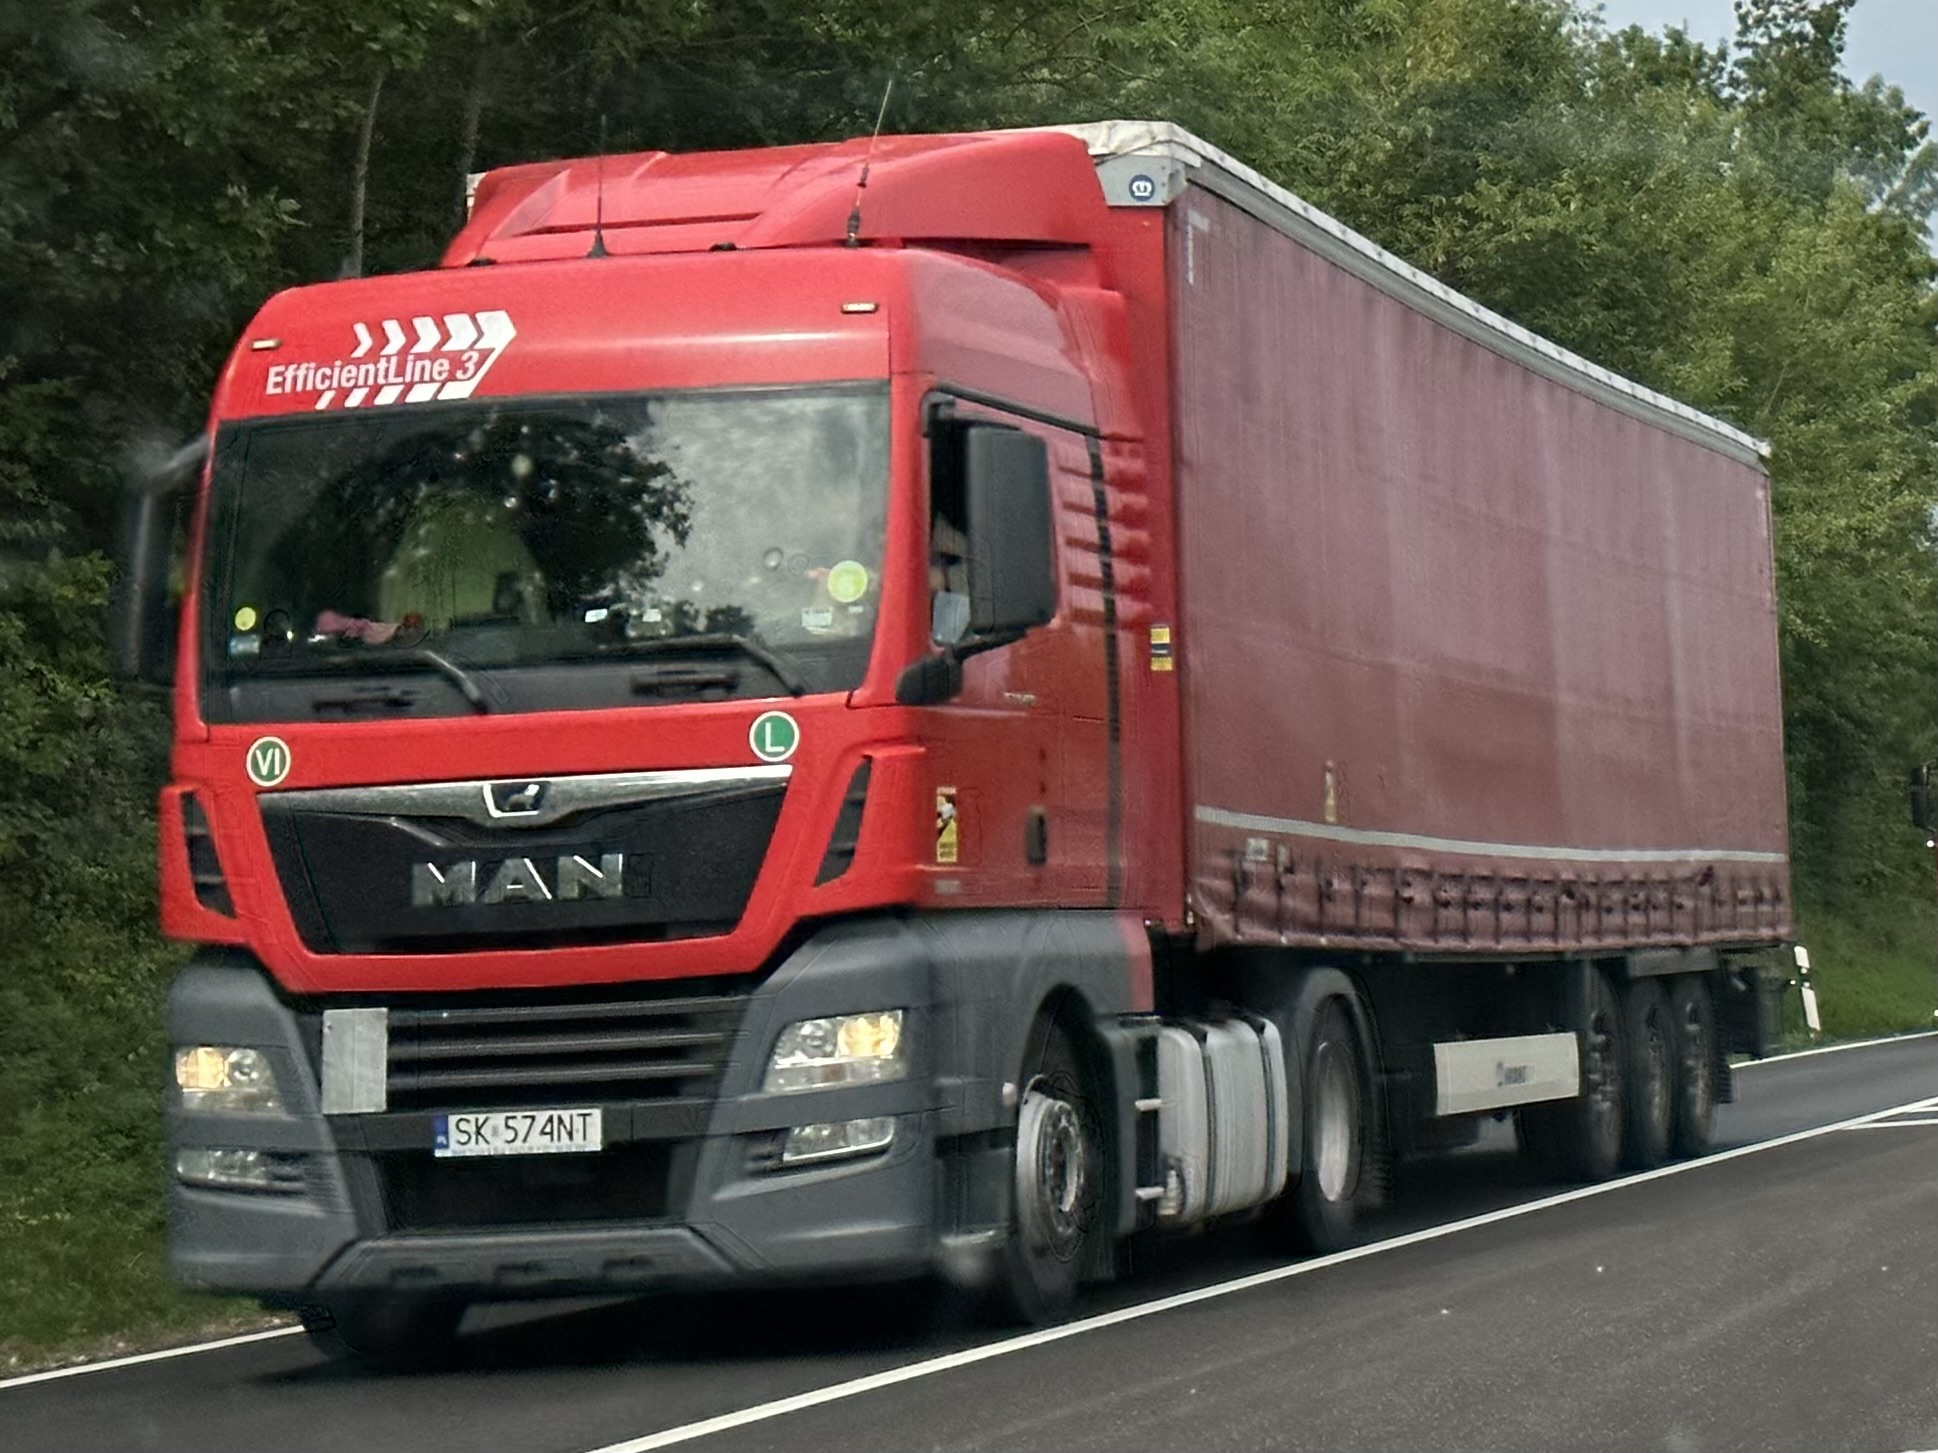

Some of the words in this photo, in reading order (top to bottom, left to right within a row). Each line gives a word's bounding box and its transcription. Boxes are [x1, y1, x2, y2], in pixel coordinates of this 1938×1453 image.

[265, 354, 450, 395] EfficientLine
[455, 350, 480, 380] 3
[765, 721, 786, 753] L
[255, 747, 280, 776] VI
[411, 853, 624, 906] MAN
[455, 1116, 491, 1146] SK
[504, 1112, 593, 1144] 574NT
